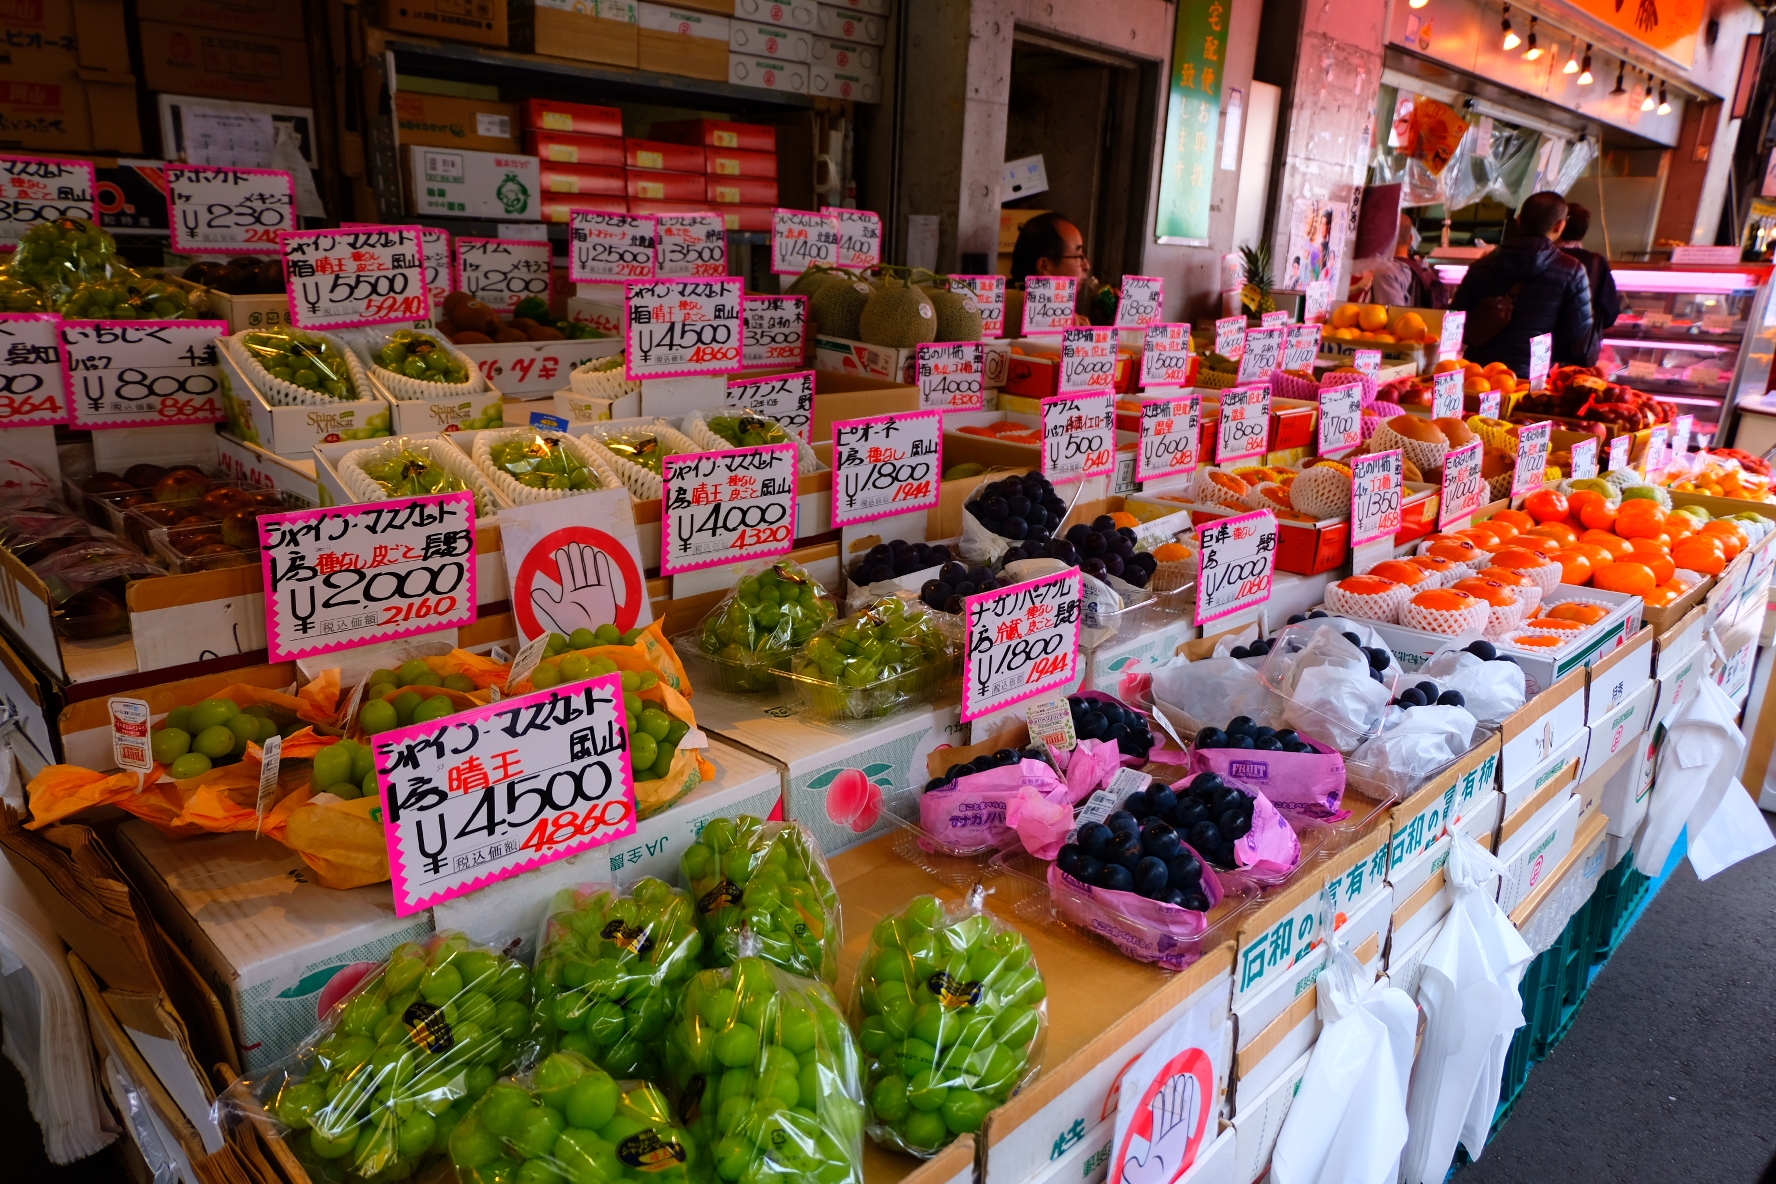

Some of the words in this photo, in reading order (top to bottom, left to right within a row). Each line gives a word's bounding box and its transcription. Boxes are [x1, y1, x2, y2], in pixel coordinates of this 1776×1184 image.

[211, 203, 284, 228] 230
[461, 240, 512, 255] ライム
[391, 253, 422, 270] 岡山
[479, 270, 549, 293] 200
[713, 304, 738, 321] 岡山
[1127, 300, 1153, 316] 800
[61, 324, 172, 345] いちじく
[1253, 353, 1275, 368] 750
[115, 368, 218, 400] 800
[157, 397, 223, 418] 864
[430, 403, 460, 419] Shine
[1043, 399, 1080, 417] プラム
[1443, 395, 1461, 415] 900
[307, 411, 337, 427] Shine
[316, 416, 355, 435] Muscat
[437, 408, 471, 426] Muscat
[1330, 416, 1353, 437] 700
[1233, 421, 1263, 441] 800
[866, 446, 905, 464] 種なし
[910, 439, 938, 458] 岡山
[1065, 433, 1103, 459] 500
[1155, 434, 1189, 458] 600
[1082, 449, 1110, 472] 540
[691, 482, 724, 507] 晴王
[760, 477, 790, 498] 岡山
[314, 551, 367, 576] 種なし
[370, 543, 424, 569] 皮ごと
[421, 530, 474, 561] 長野
[970, 578, 1071, 628] ナガノパープル
[322, 613, 377, 635] 税込価額
[569, 720, 627, 763] 岡山
[448, 748, 524, 795] 晴王
[1232, 762, 1266, 777] FRUIT
[455, 839, 519, 870] 税込価額
